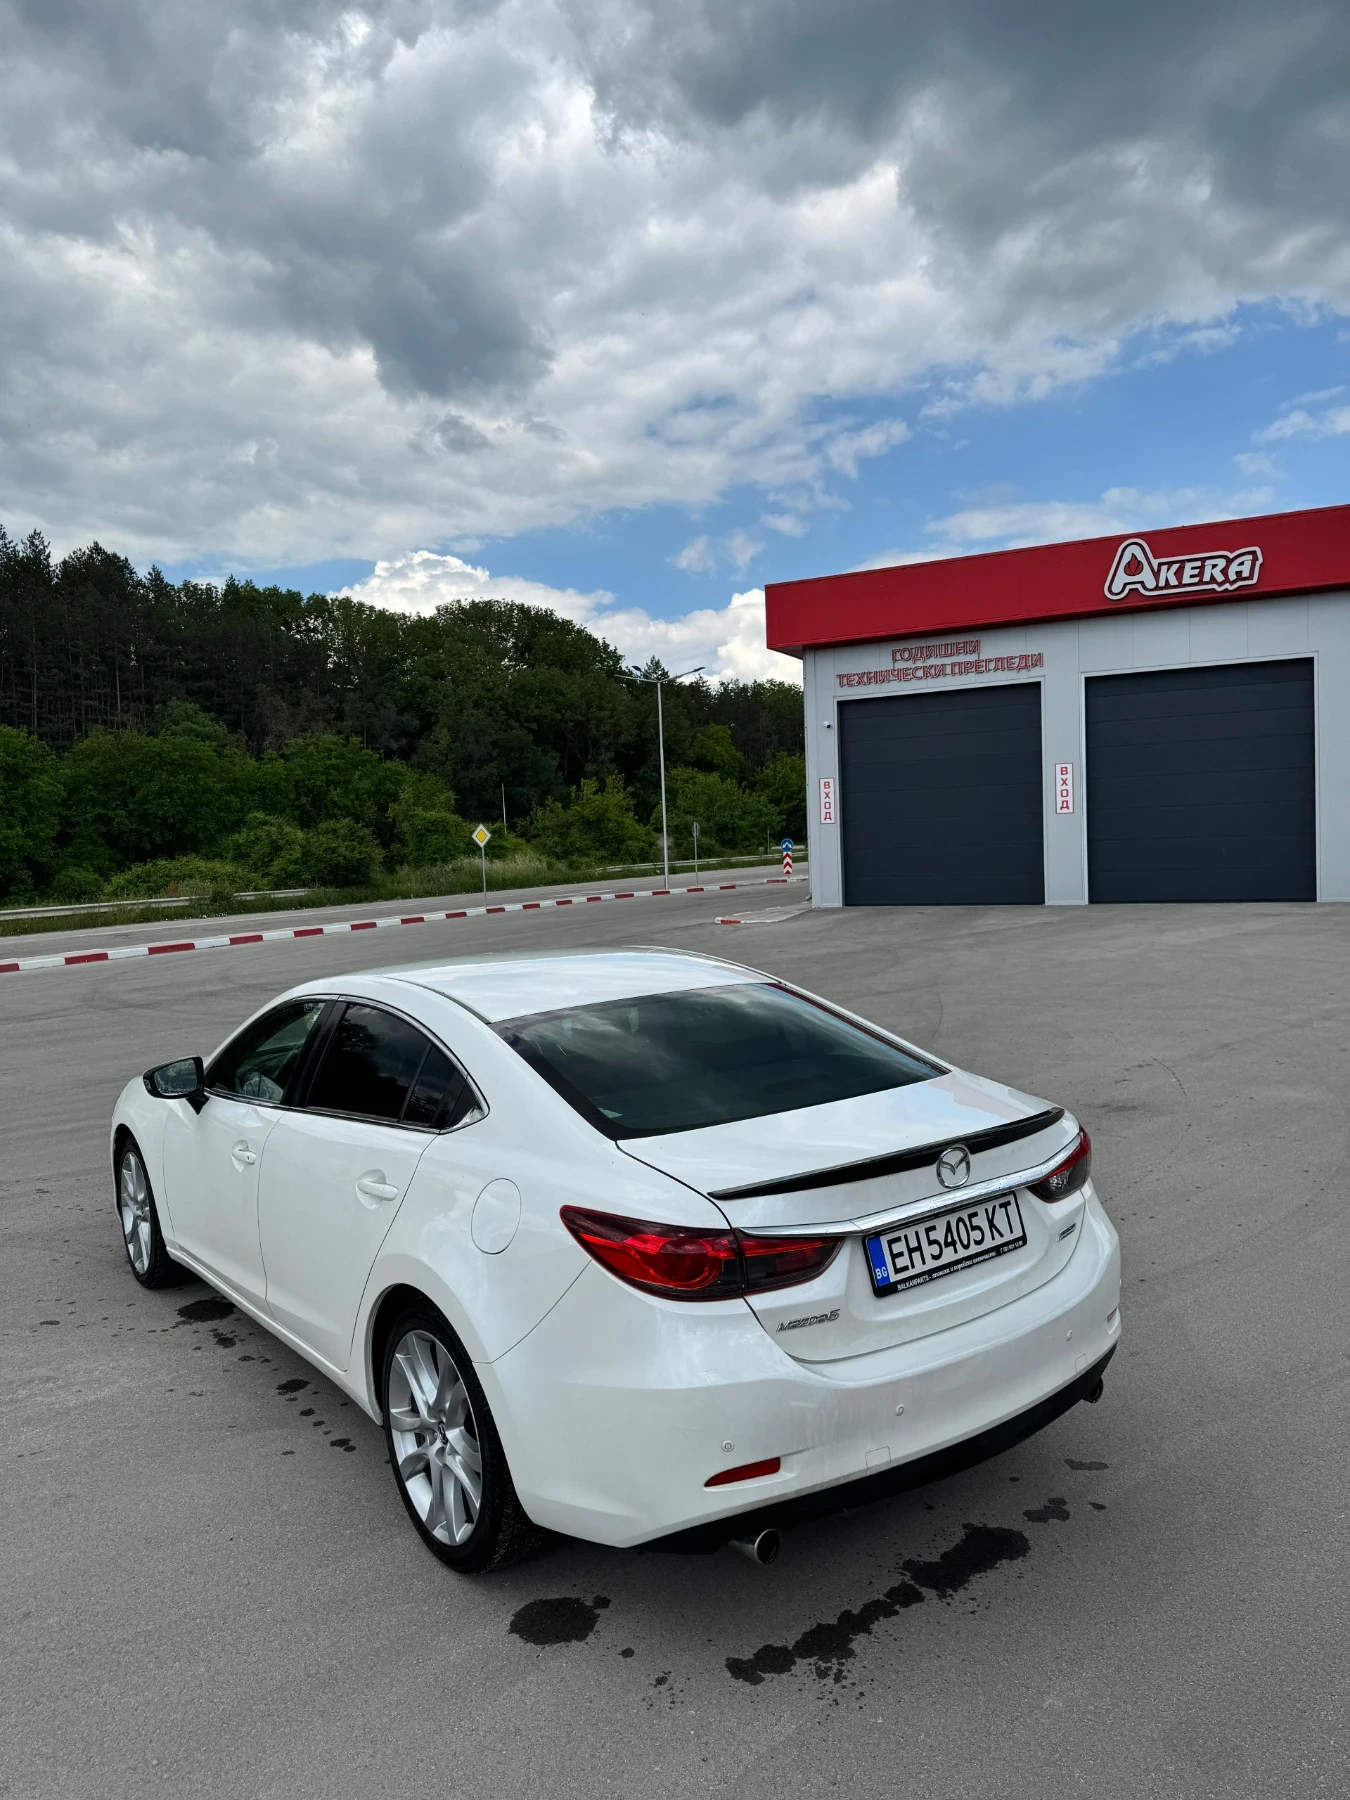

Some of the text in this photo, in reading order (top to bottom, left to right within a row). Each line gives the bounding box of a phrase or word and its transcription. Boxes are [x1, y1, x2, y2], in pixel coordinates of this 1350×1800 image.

[1111, 543, 1253, 594] AKERA
[836, 652, 1045, 688] ТЕХНИЧЕСКИ ПРЕГЛЕДИ
[891, 639, 981, 663] ГОДИШНИ
[823, 781, 832, 821] ВХОД
[1060, 766, 1070, 811] ВХОД
[875, 1267, 888, 1280] BG
